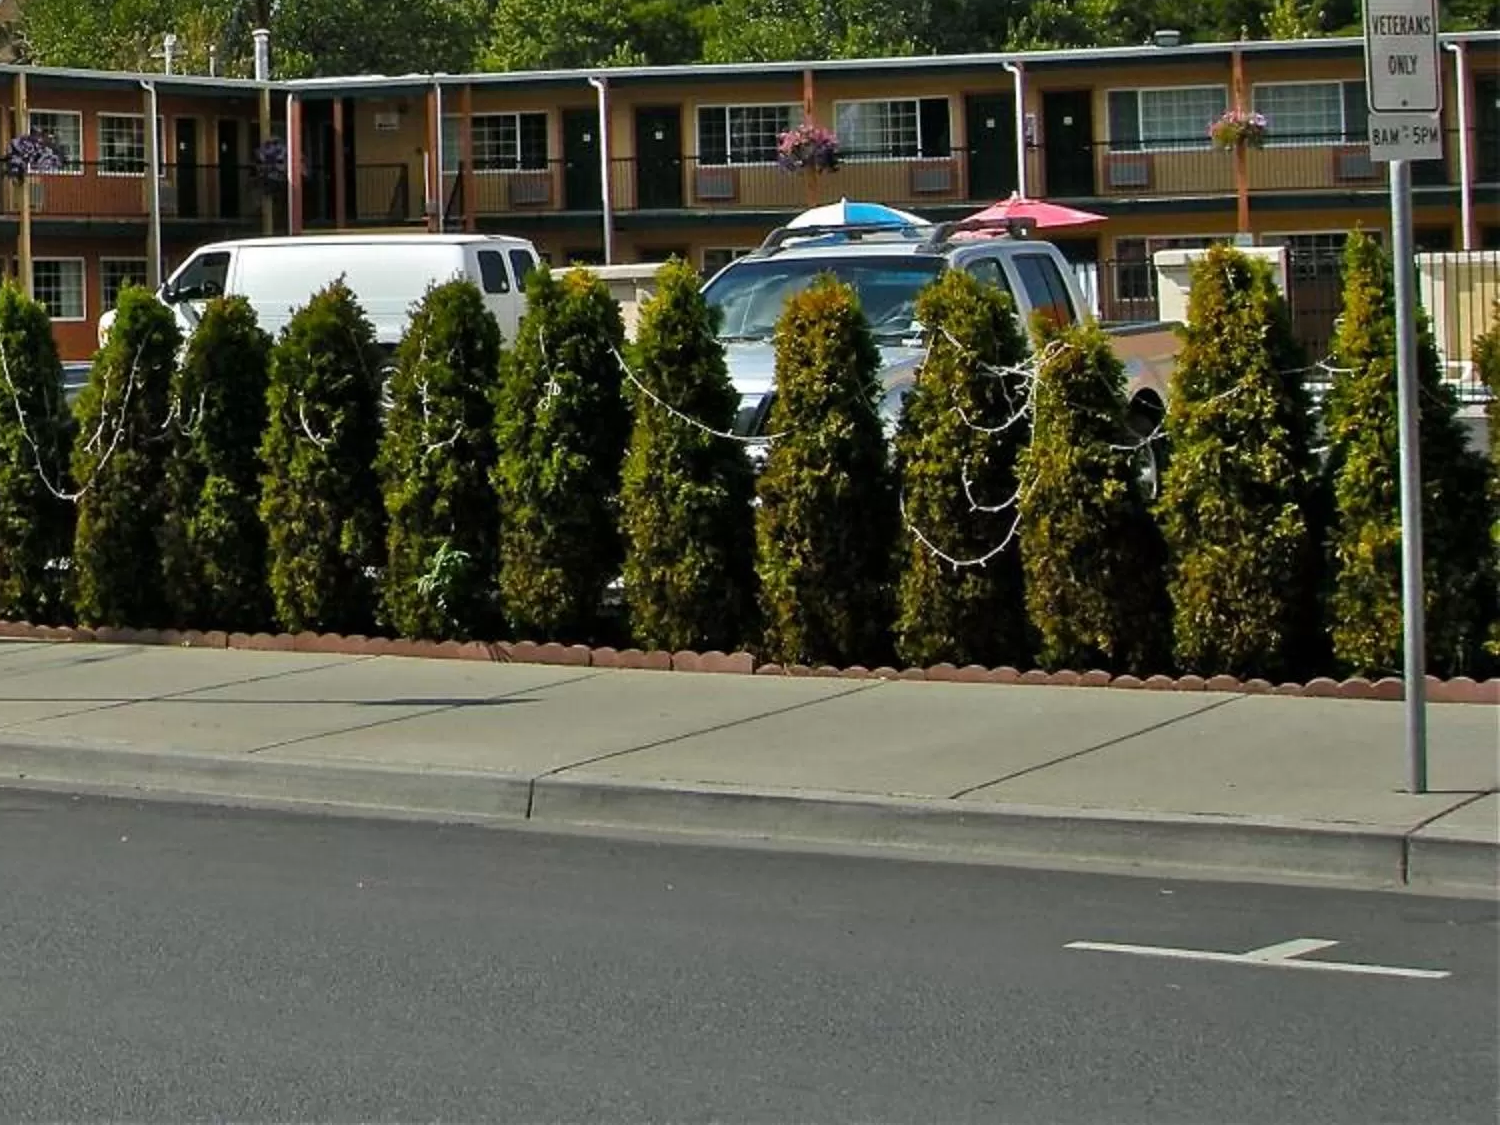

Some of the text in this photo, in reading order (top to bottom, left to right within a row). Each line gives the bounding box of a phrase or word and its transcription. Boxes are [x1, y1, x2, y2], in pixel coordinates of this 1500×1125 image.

[1371, 15, 1431, 36] VETERANS
[1388, 55, 1418, 75] ONLY
[1413, 126, 1438, 144] 5PM
